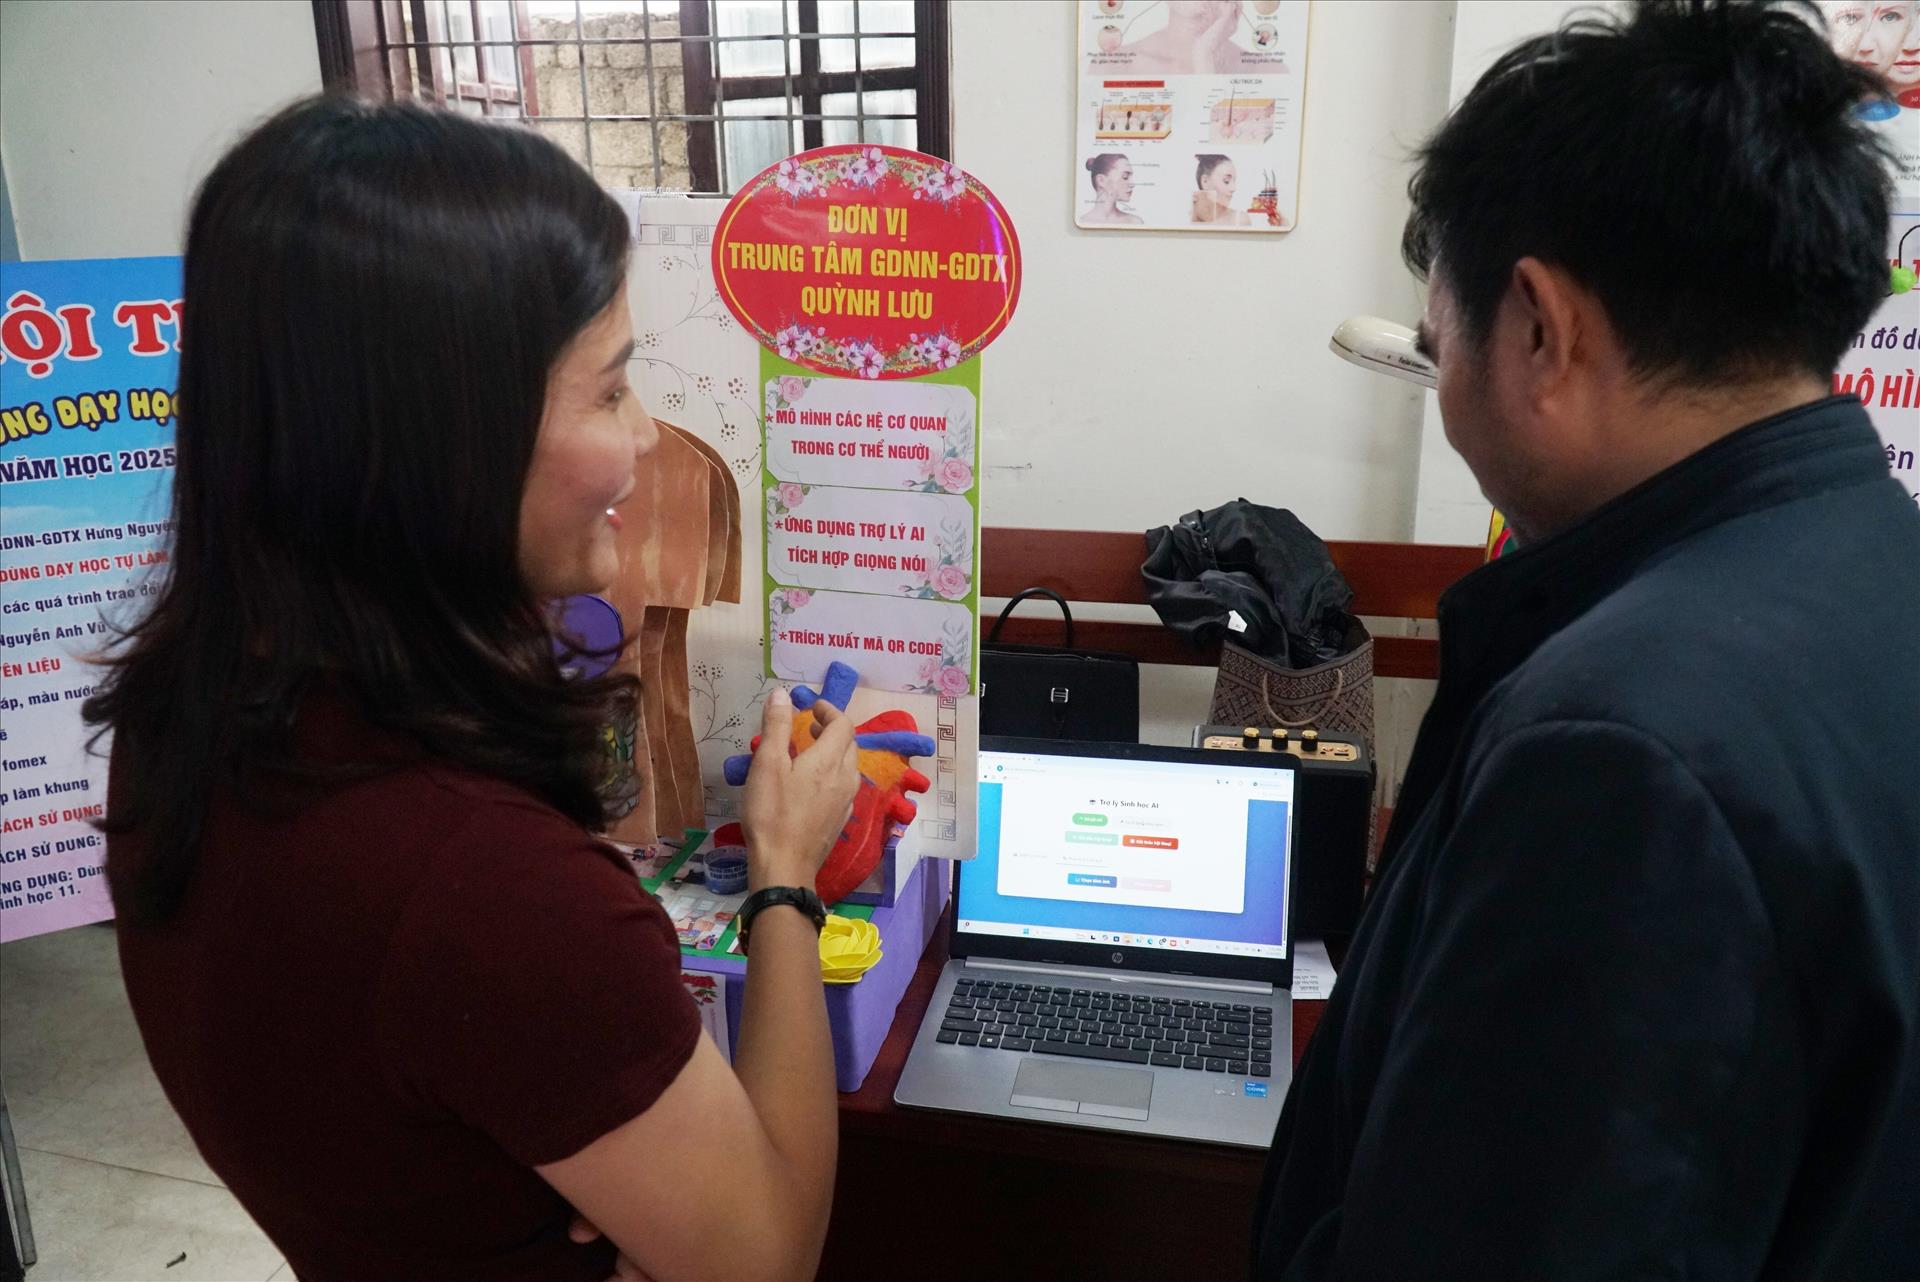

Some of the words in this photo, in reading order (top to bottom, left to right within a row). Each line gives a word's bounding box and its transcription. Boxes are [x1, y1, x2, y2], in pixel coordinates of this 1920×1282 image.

[828, 203, 878, 235] ĐƠN
[886, 208, 908, 242] VỊ
[728, 242, 805, 272] TRUNG
[812, 241, 862, 276] TÂM
[871, 249, 1008, 283] GDNN-GDTX
[801, 281, 881, 318] QUỲNH
[888, 290, 934, 320] LƯU
[0, 291, 102, 376] ỘI
[1871, 326, 1899, 350] đồ
[1831, 368, 1875, 408] MÔ
[53, 391, 121, 432] DẠY
[776, 410, 797, 424] MÔ
[800, 408, 832, 426] HÌNH
[835, 410, 862, 428] CÁC
[866, 412, 883, 432] HỆ
[887, 414, 906, 430] CƠ
[909, 416, 947, 432] QUAN
[791, 440, 834, 456] TRONG
[838, 442, 856, 458] CƠ
[860, 439, 885, 459] THỂ
[888, 443, 930, 461] NGƯỜI
[0, 456, 58, 483] NĂM
[64, 450, 113, 481] HỌC
[0, 529, 81, 551] DNN-GDTX
[85, 528, 123, 540] Hưng
[784, 516, 812, 533] ỨNG
[817, 520, 855, 538] DỤNG
[860, 522, 886, 541] TRỢ
[889, 524, 905, 541] LÝ
[910, 527, 925, 541] AI
[45, 561, 74, 578] DẠY
[79, 558, 110, 575] HỌC
[114, 553, 134, 571] TỰ
[138, 549, 169, 566] LÀM
[788, 547, 818, 564] TÍCH
[822, 550, 849, 568] HỢP
[854, 553, 897, 570] GIỌNG
[901, 554, 926, 572] NÓI
[3, 600, 30, 615] các
[35, 595, 63, 612] quá
[67, 592, 102, 606] trình
[106, 588, 136, 602] trao
[0, 627, 51, 648] Nguyễn
[55, 624, 84, 640] Anh
[788, 630, 824, 646] TRÍCH
[828, 629, 860, 648] XUẤT
[863, 636, 884, 651] MÃ
[887, 639, 905, 653] QR
[908, 641, 943, 657] CODE
[0, 662, 24, 679] ÊN
[27, 656, 61, 675] LIỆU
[28, 691, 59, 706] màu
[2, 756, 48, 772] fomex
[13, 788, 41, 802] làm
[45, 778, 90, 796] khung
[0, 817, 34, 834] ÁCH
[38, 809, 58, 826] SỬ
[62, 804, 103, 822] DỤNG
[31, 841, 51, 858] SỬ
[0, 879, 22, 896] NG
[26, 871, 73, 890] DỤNG:
[27, 890, 53, 905] học
[58, 884, 81, 897] 11.
